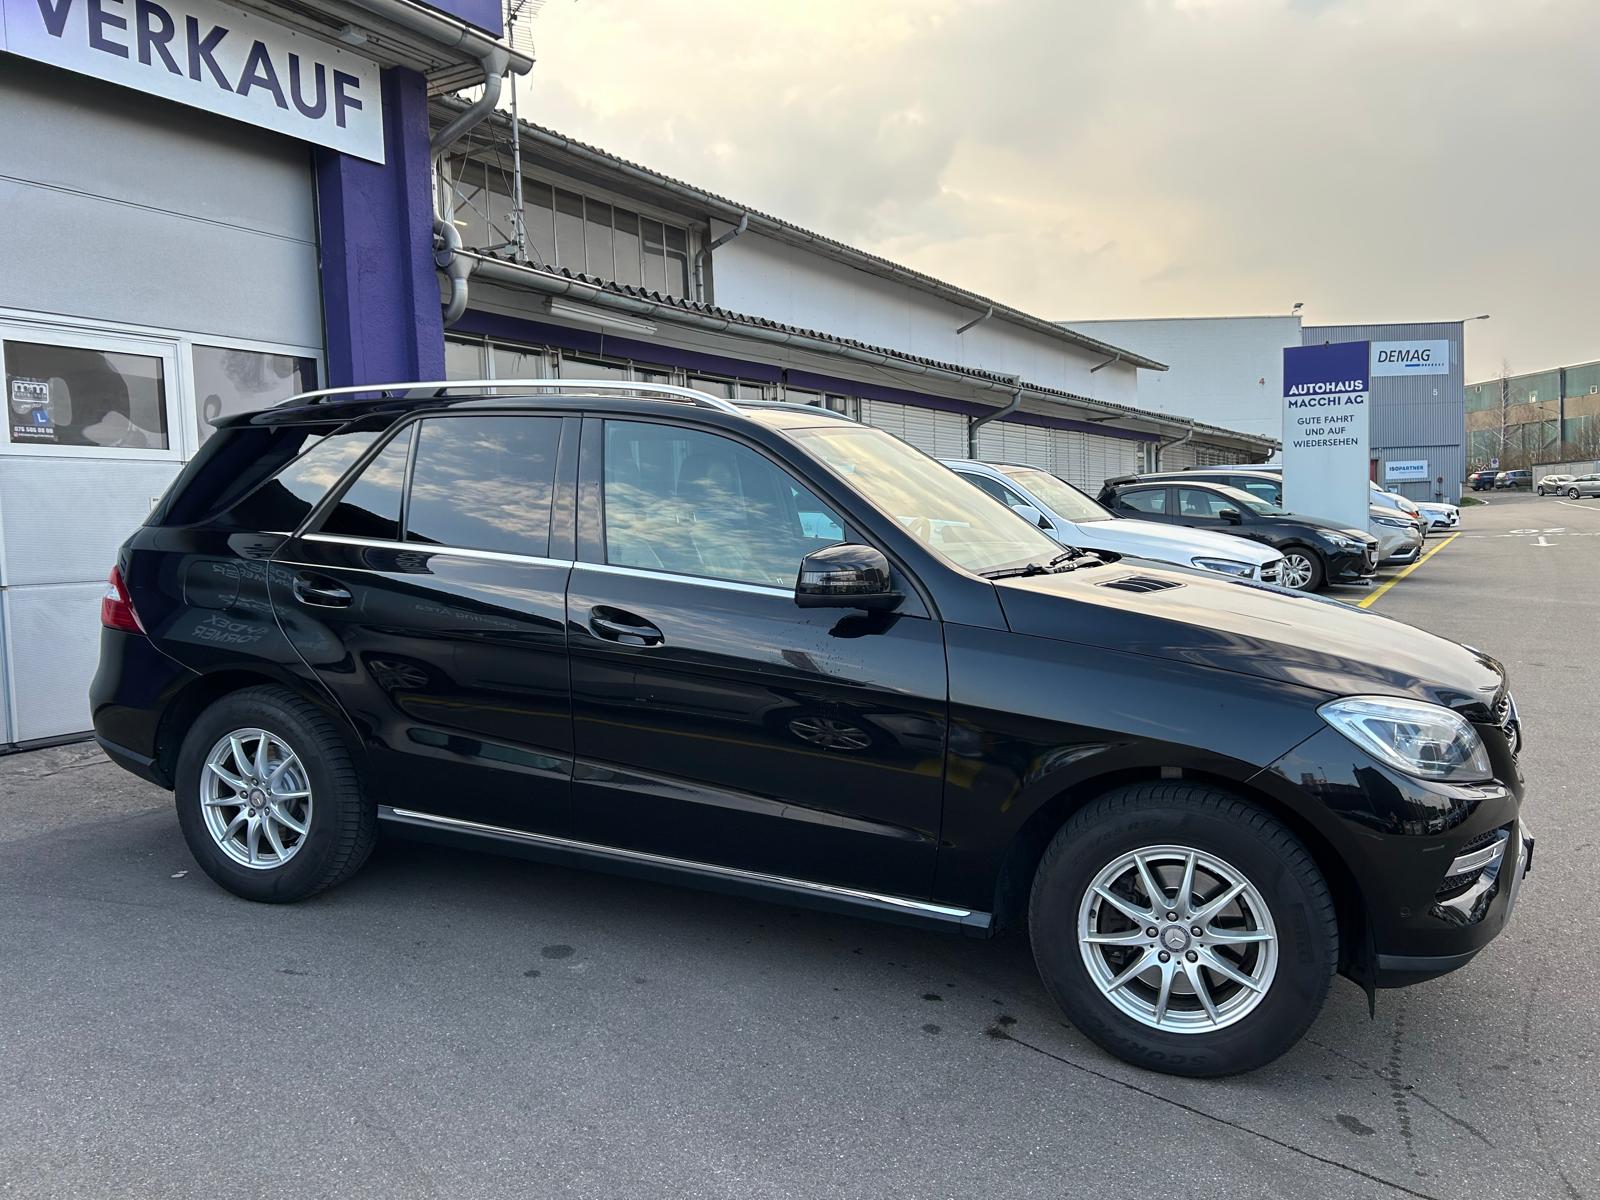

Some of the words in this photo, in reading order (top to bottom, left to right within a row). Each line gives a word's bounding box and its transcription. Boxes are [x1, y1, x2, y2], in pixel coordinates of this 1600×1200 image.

[36, 0, 363, 129] VERKAUF
[1378, 349, 1431, 363] DEMAG
[1289, 380, 1363, 395] AUTOHAUS
[1288, 396, 1341, 409] MACCHI
[1344, 395, 1364, 405] AG
[1297, 416, 1321, 425] GUTE
[1324, 414, 1355, 424] FAHRT
[1305, 428, 1325, 436] UND
[1327, 426, 1347, 435] AUF
[1293, 438, 1358, 447] WIEDERSEHEN
